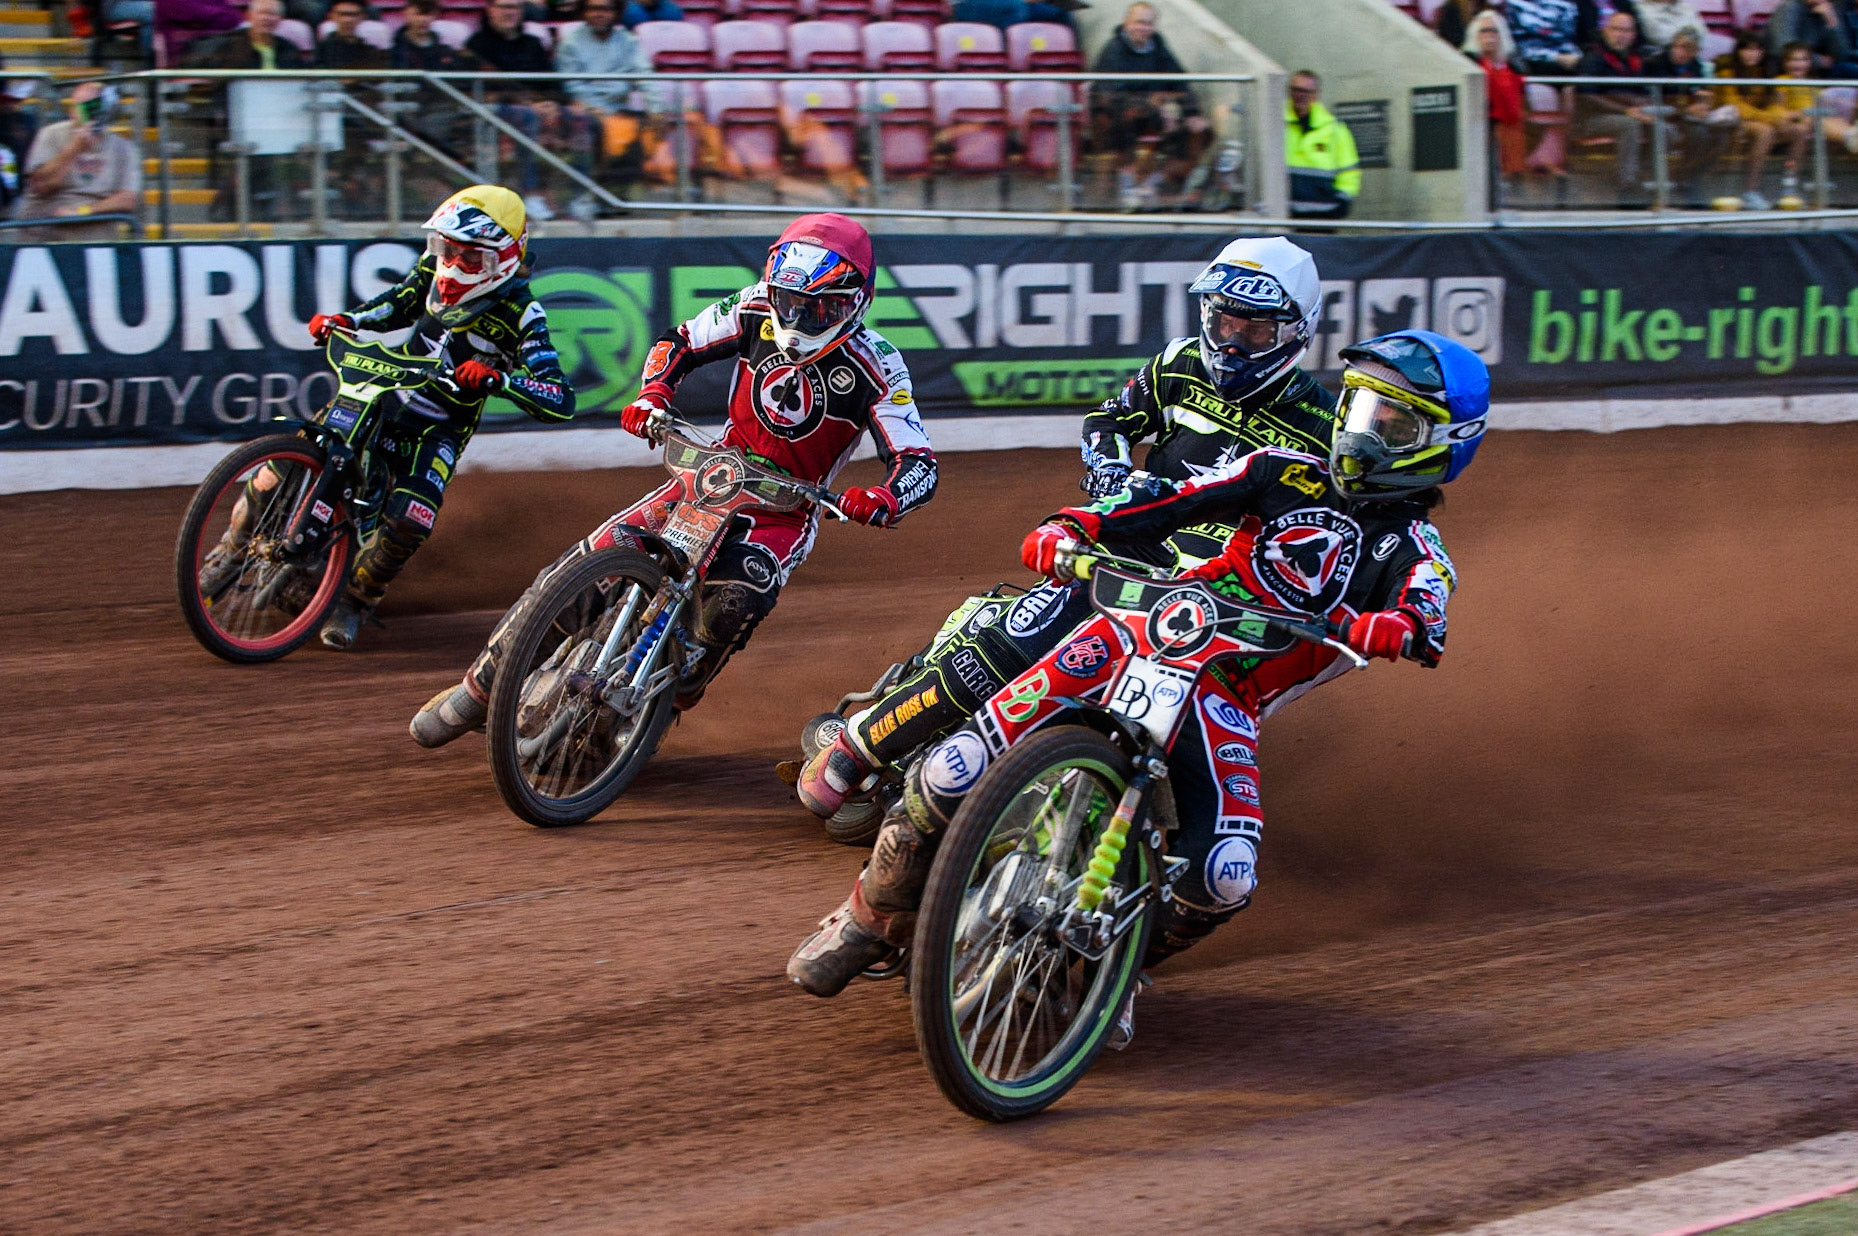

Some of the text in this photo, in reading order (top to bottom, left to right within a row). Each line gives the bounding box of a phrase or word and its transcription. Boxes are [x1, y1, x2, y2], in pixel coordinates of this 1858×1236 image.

[1527, 285, 1858, 374] bike-right
[810, 378, 823, 407] ACES
[1194, 390, 1233, 417] TRU
[315, 503, 331, 517] NGK
[410, 503, 435, 520] NGK
[663, 528, 709, 551] PREMIER
[1276, 513, 1326, 530] BELLE
[1331, 520, 1356, 541] VUE
[1157, 592, 1183, 611] BELLE
[1186, 592, 1204, 603] VUE
[868, 684, 940, 746] ELLIE ROSE UK
[944, 744, 970, 781] ATPI
